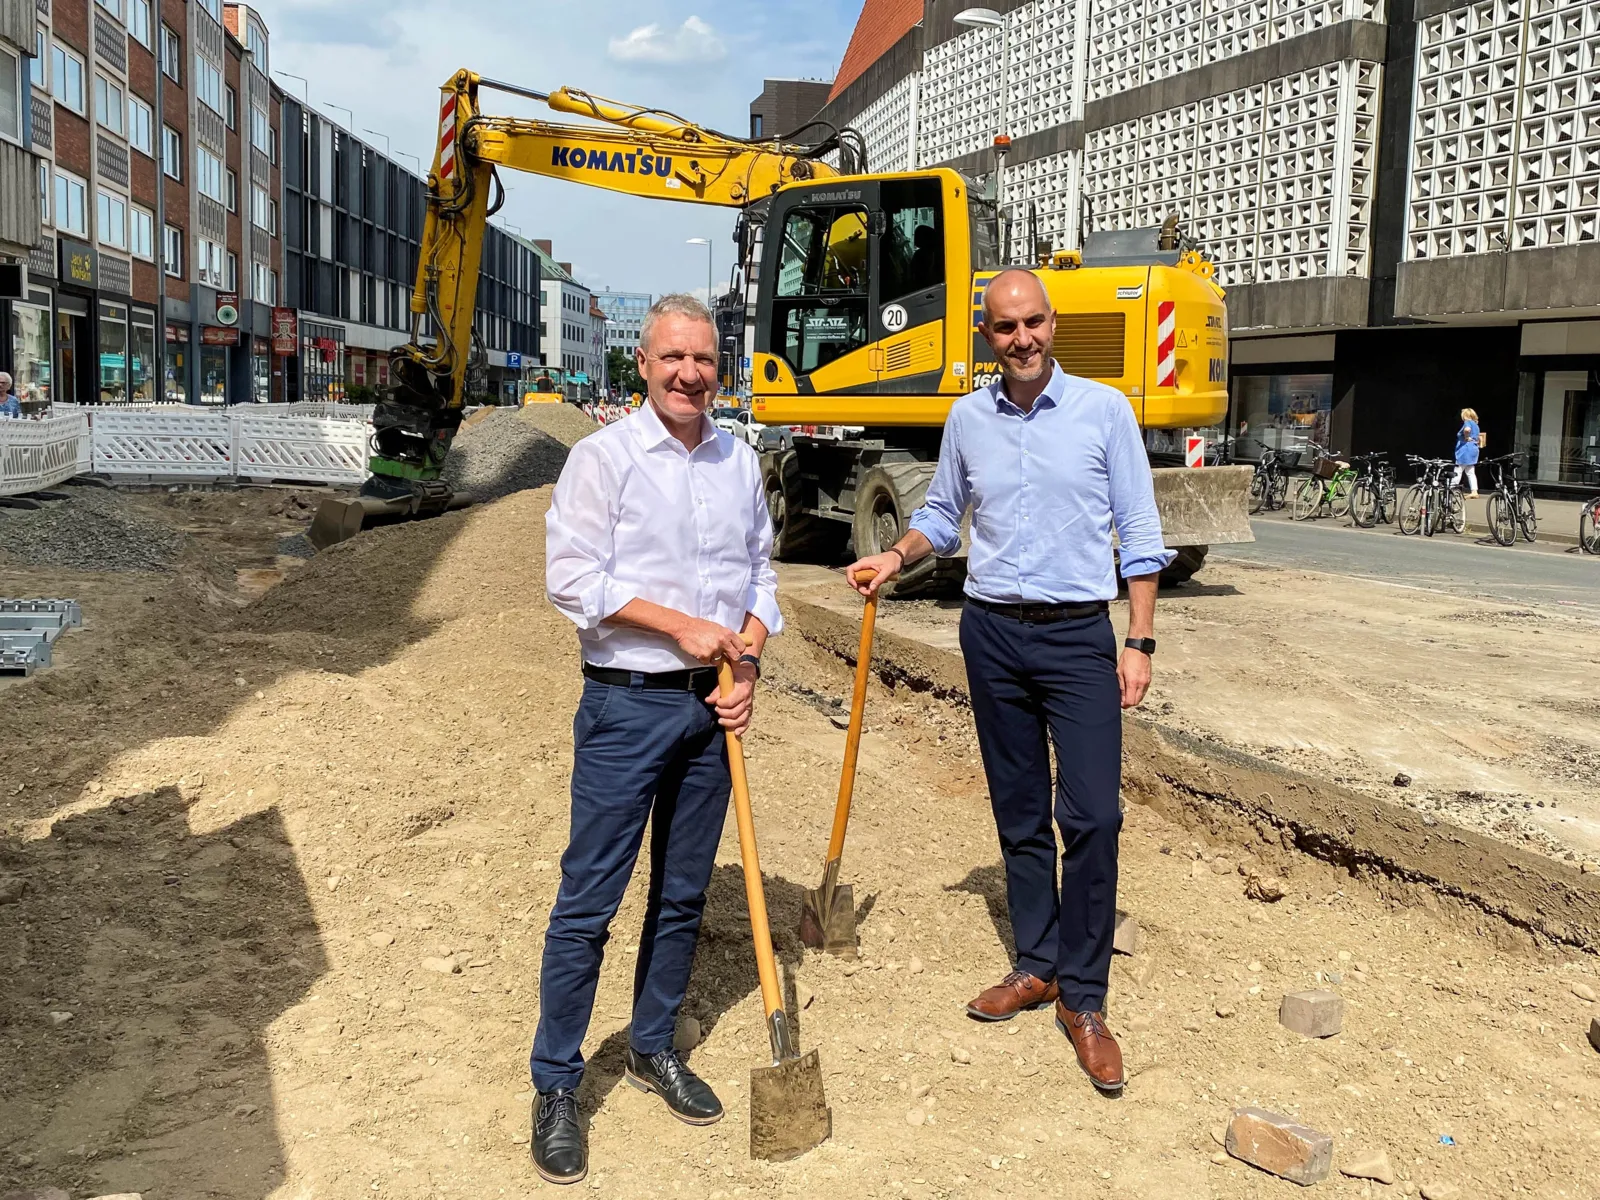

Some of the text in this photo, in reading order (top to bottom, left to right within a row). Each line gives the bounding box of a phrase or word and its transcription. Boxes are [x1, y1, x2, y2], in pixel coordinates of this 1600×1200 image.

[552, 146, 672, 177] KOMATSU
[811, 189, 861, 202] KOMATSU
[71, 252, 83, 267] Jack
[71, 264, 92, 282] Wolfskin
[887, 309, 903, 326] 20
[973, 361, 998, 373] PW
[973, 373, 1002, 389] 160
